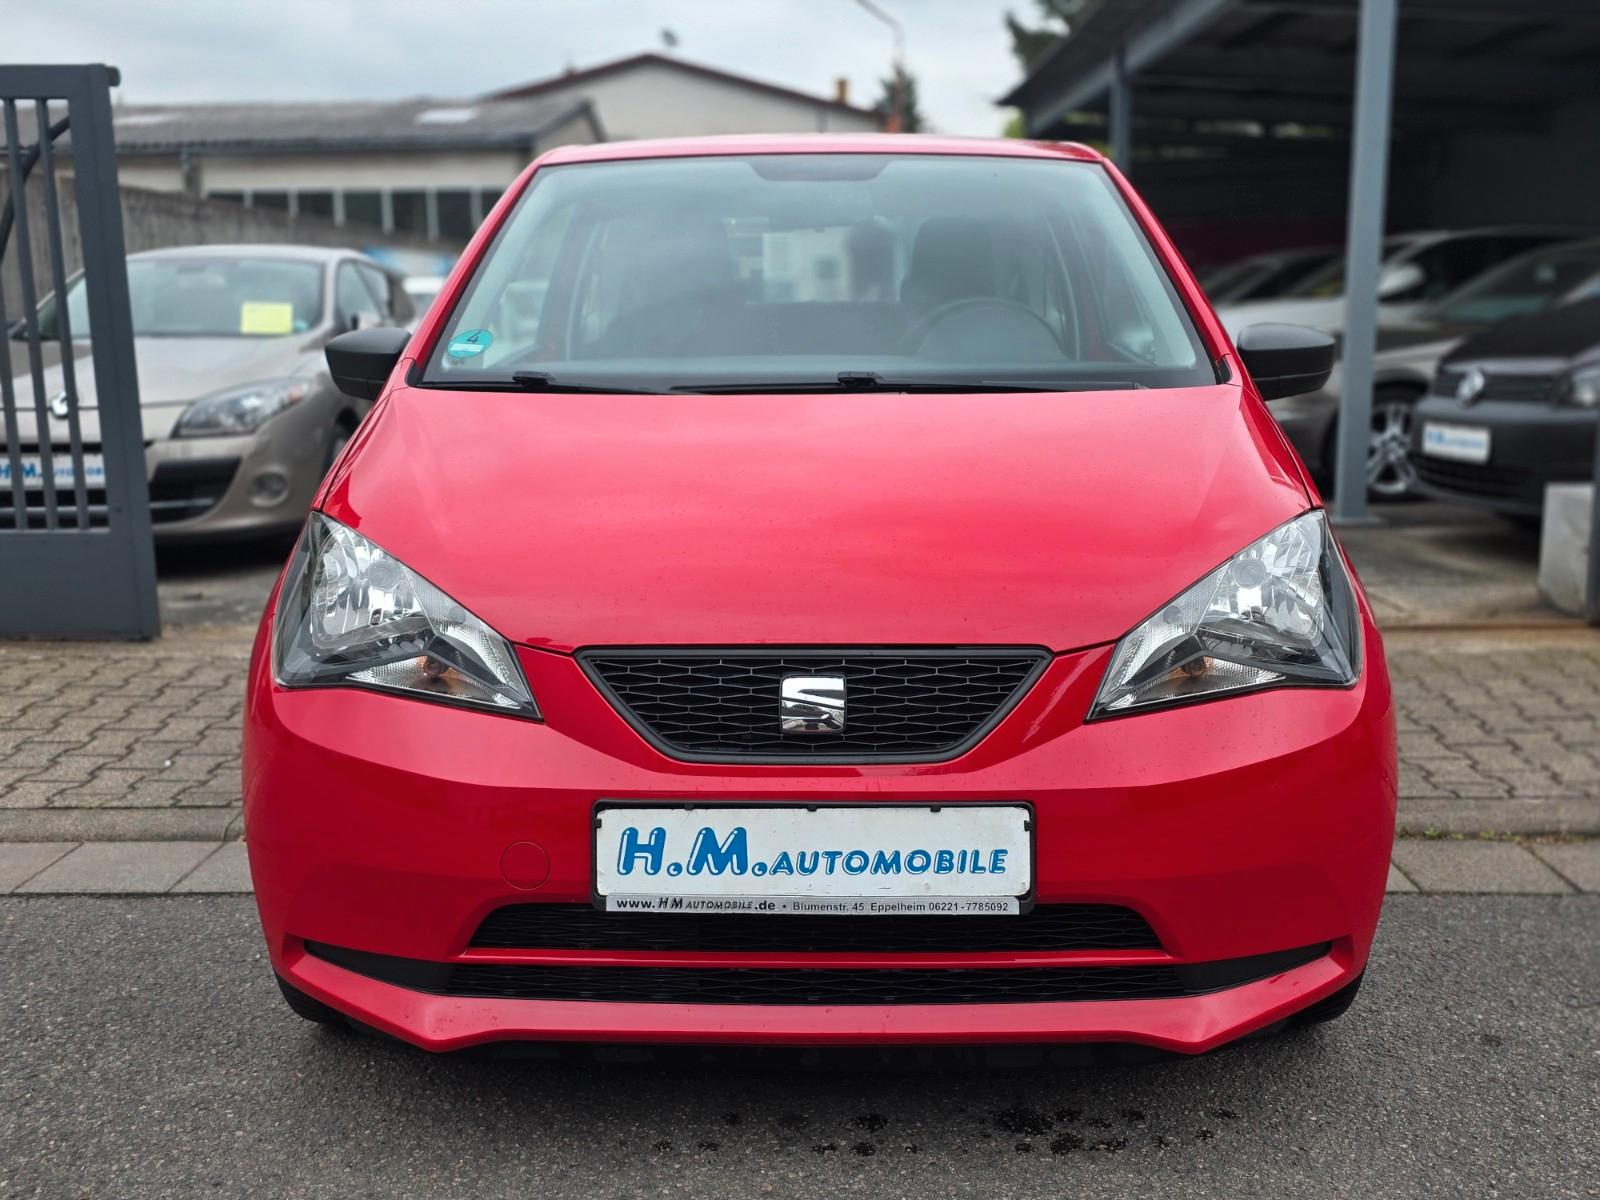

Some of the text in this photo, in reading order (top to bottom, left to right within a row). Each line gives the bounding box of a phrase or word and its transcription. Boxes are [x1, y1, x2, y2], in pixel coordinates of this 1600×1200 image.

[466, 330, 482, 344] 4
[793, 902, 849, 912] Blumenstr.
[852, 902, 865, 912] 45
[870, 902, 926, 914] Eppelheim
